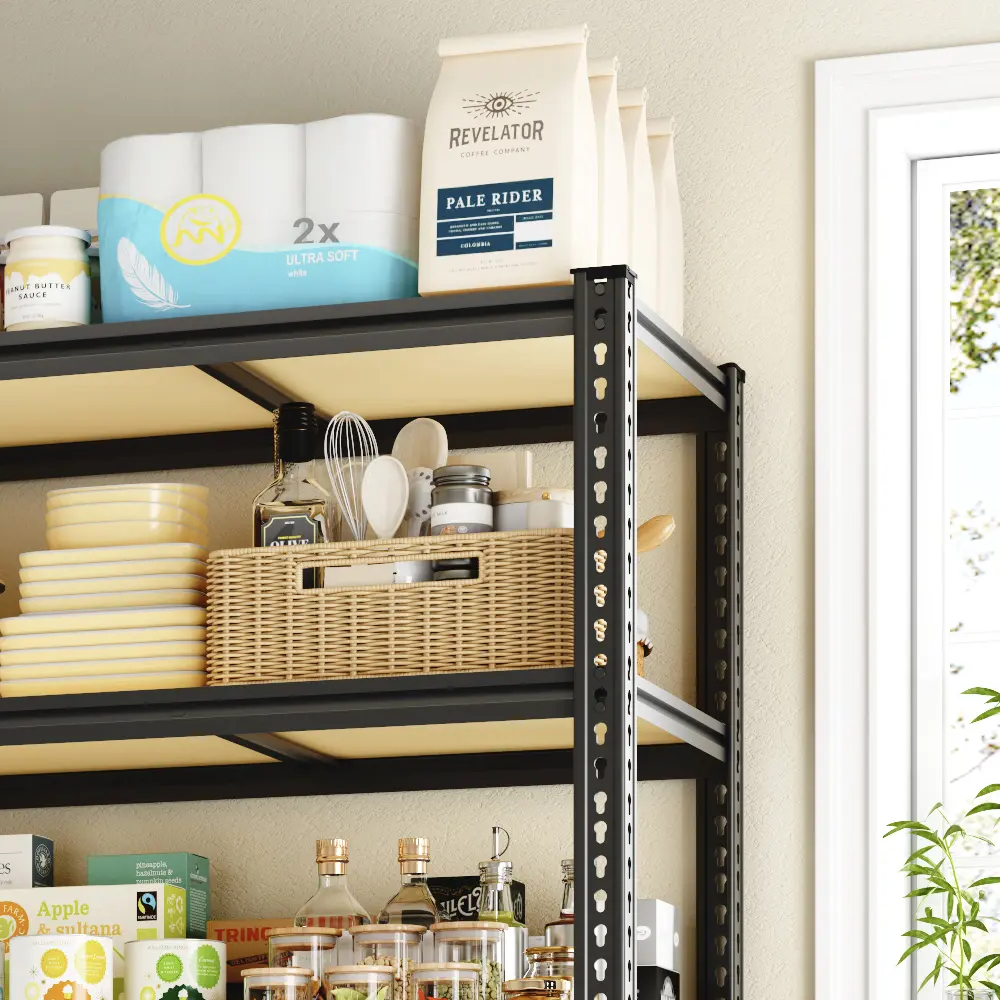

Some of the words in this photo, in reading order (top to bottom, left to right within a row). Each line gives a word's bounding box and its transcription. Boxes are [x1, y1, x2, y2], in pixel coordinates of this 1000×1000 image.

[449, 120, 544, 149] REVELATOR
[460, 150, 489, 158] COFFEE
[493, 146, 530, 155] COMPANY
[446, 194, 486, 209] PALE
[491, 188, 543, 206] RIDER
[292, 217, 340, 244] 2x
[286, 252, 325, 266] ULTRA
[327, 249, 359, 262] SOFT
[34, 282, 71, 290] BUTTER
[18, 292, 47, 300] SAUCE
[3, 903, 26, 924] FARM
[36, 899, 90, 921] Apple
[36, 923, 50, 935] &
[56, 921, 122, 935] sultana
